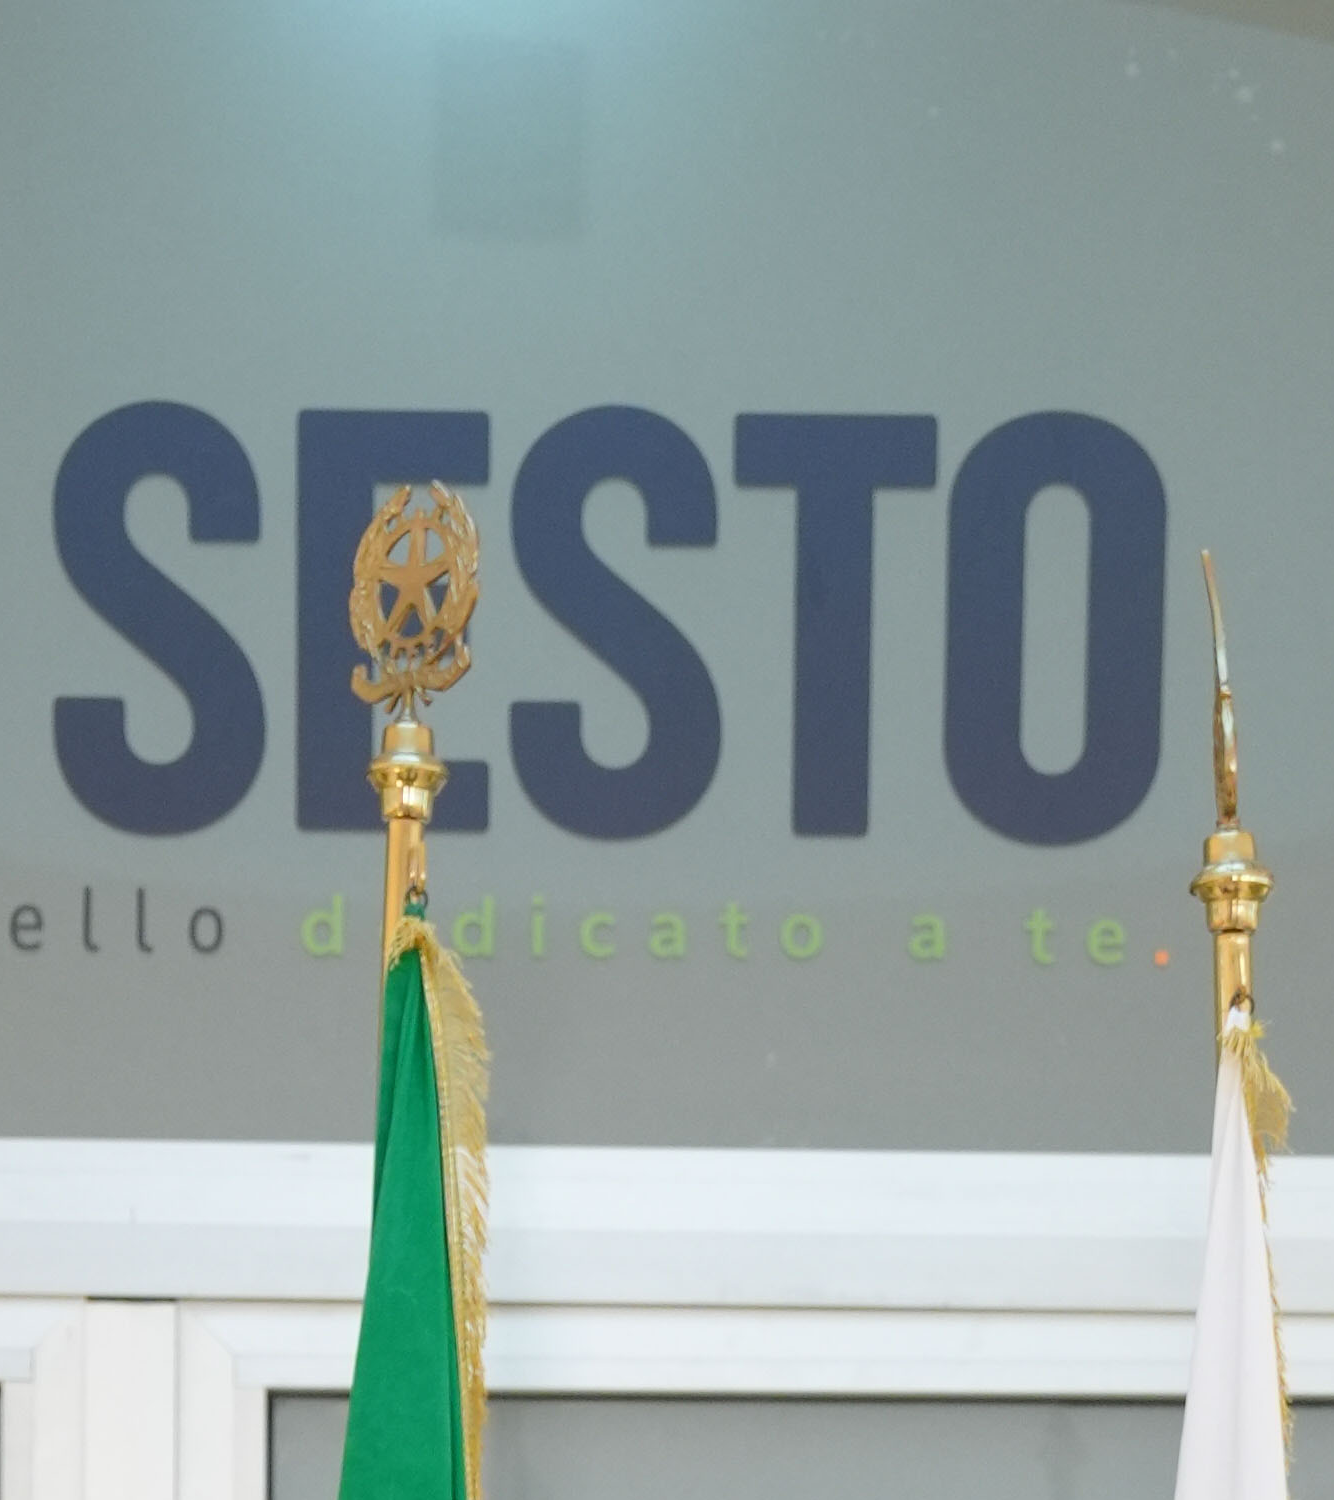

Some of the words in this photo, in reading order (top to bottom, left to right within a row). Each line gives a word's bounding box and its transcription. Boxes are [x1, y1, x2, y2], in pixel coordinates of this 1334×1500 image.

[53, 400, 1167, 848] SESTO
[300, 894, 825, 962] ddicato
[907, 911, 947, 961] a
